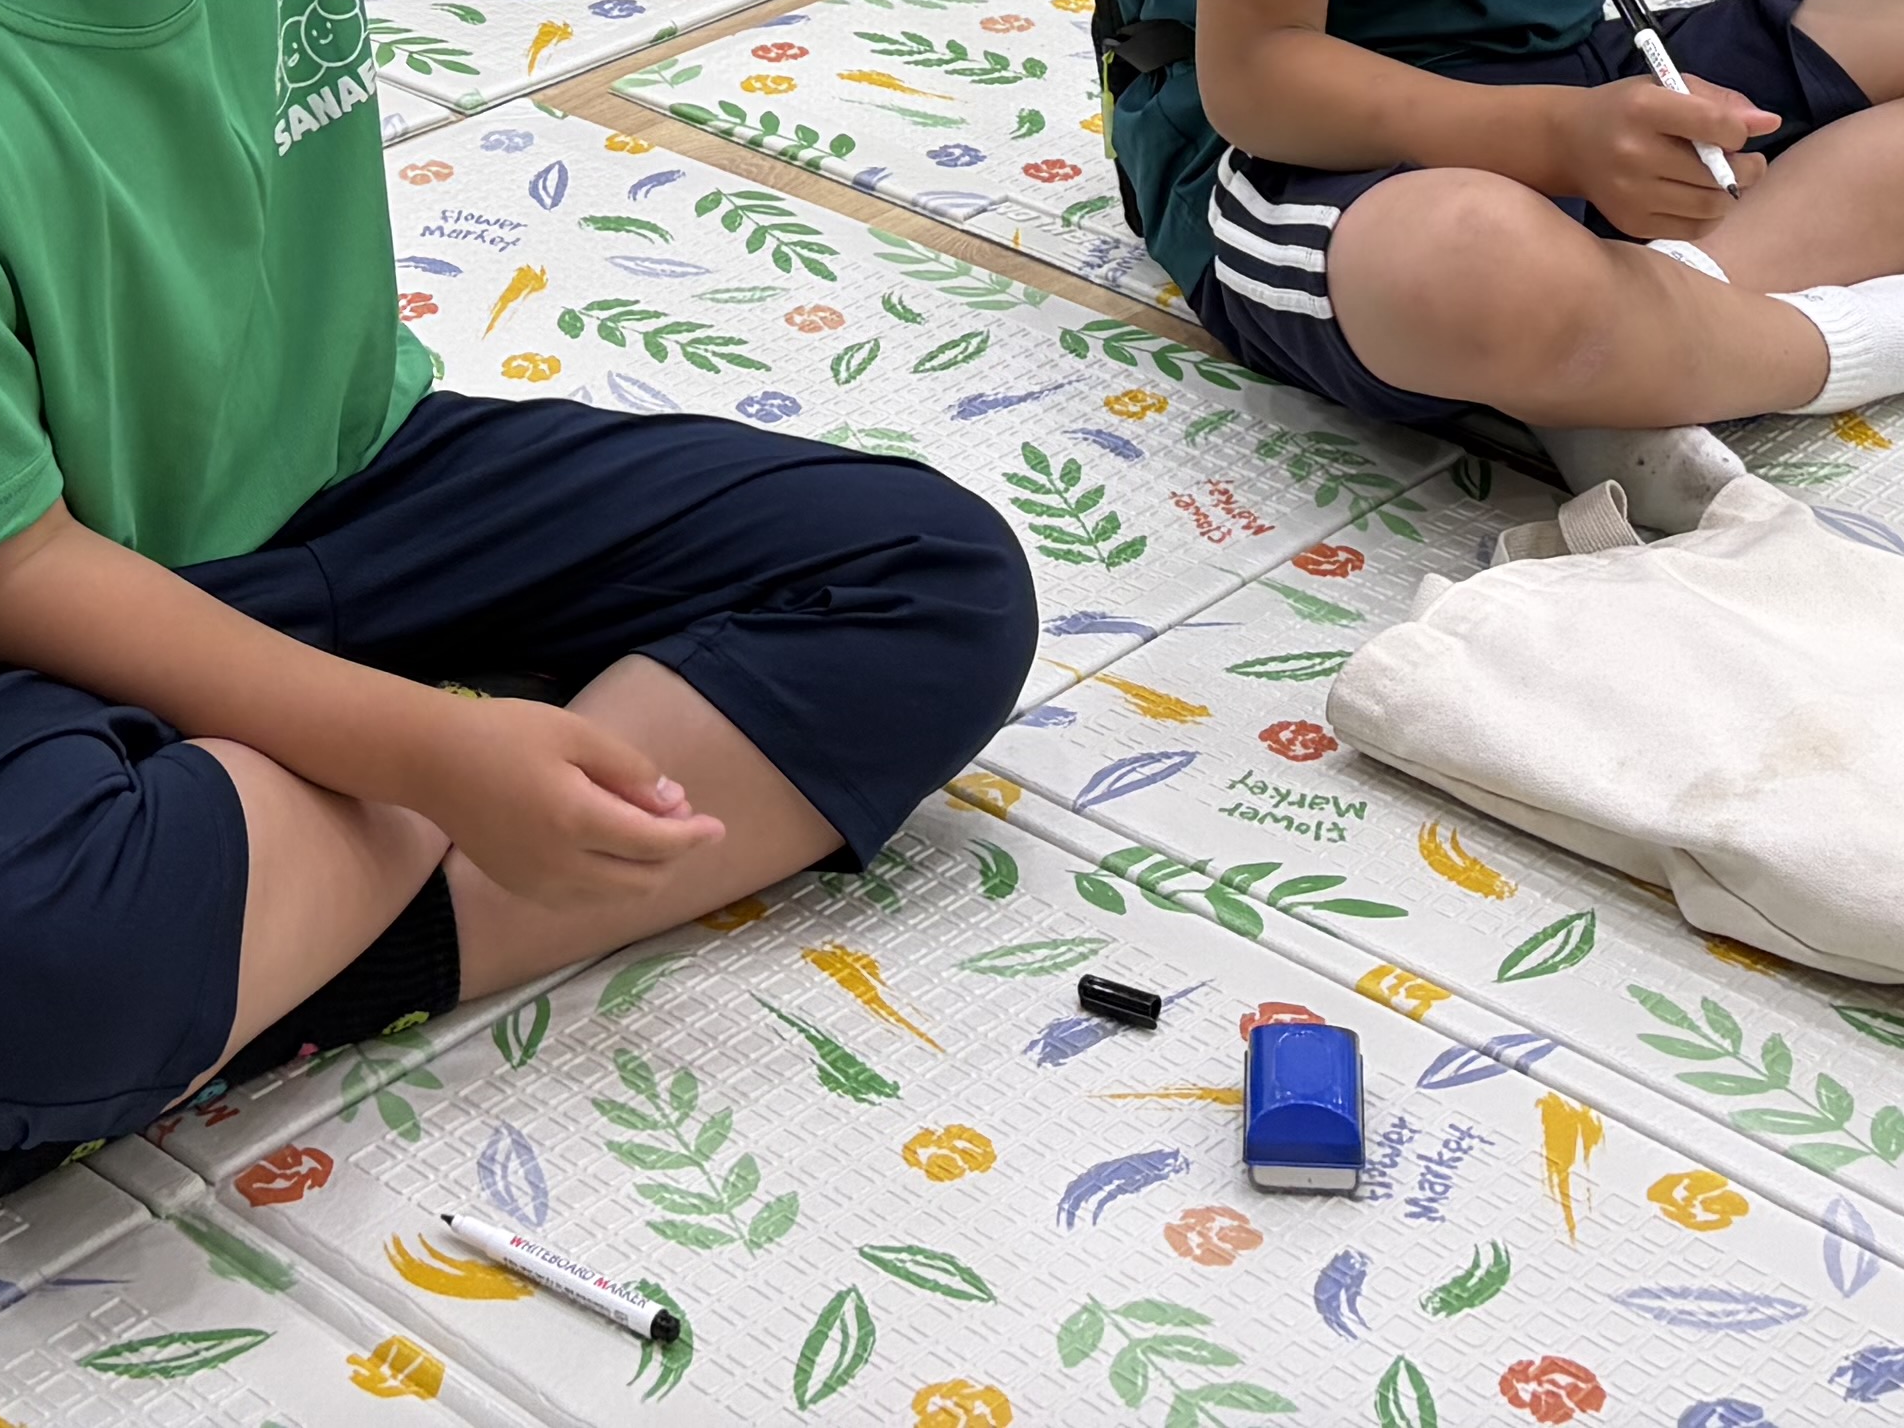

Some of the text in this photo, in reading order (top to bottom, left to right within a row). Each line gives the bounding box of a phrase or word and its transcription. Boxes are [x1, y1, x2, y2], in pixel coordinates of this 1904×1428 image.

[420, 224, 522, 253] Market
[1227, 769, 1367, 821] Market
[1404, 1123, 1494, 1223] Market
[509, 1234, 596, 1282] WHITEBOARD
[593, 1276, 649, 1310] MARKER
